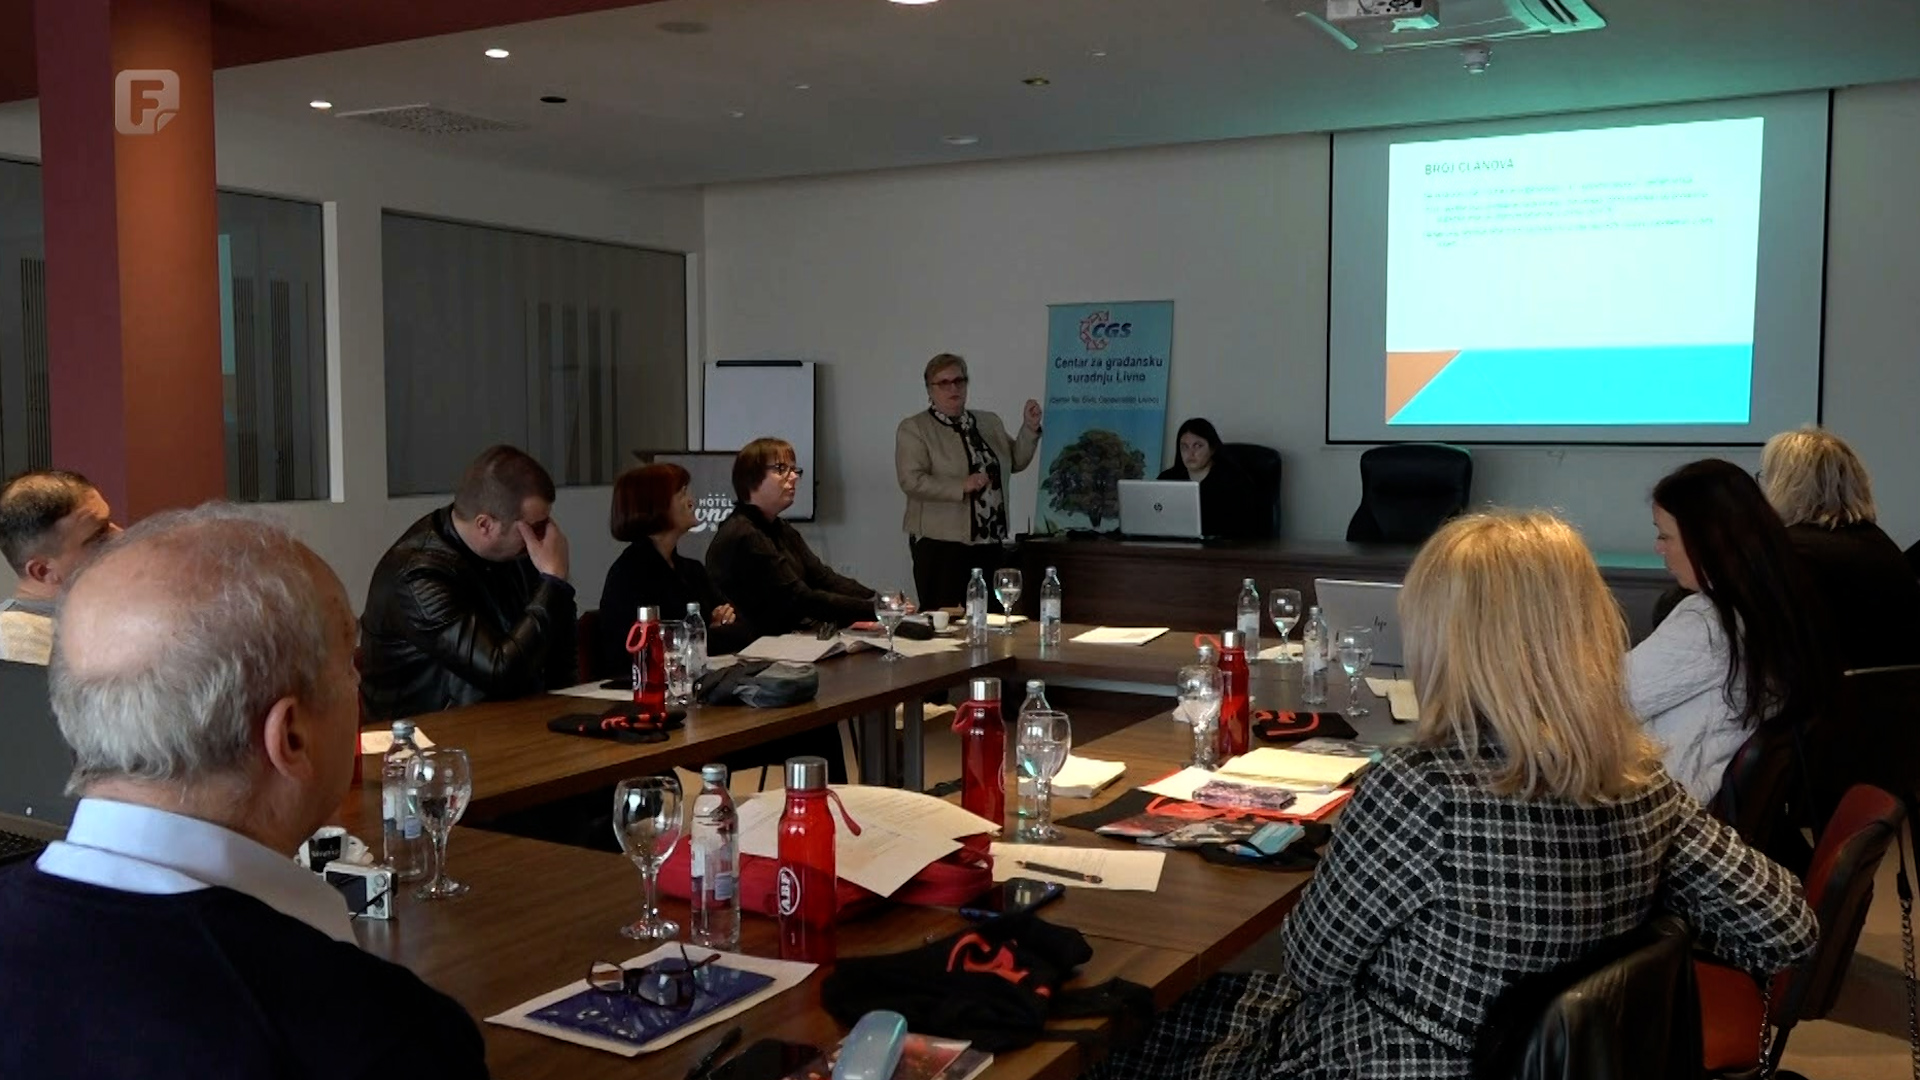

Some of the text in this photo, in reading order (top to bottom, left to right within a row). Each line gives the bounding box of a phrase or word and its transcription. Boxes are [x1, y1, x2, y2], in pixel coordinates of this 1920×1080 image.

[1092, 322, 1132, 338] CGS
[1055, 356, 1087, 369] Centar
[1091, 360, 1103, 368] za
[1067, 370, 1146, 386] suradnju Livno
[699, 498, 734, 508] HOTEL
